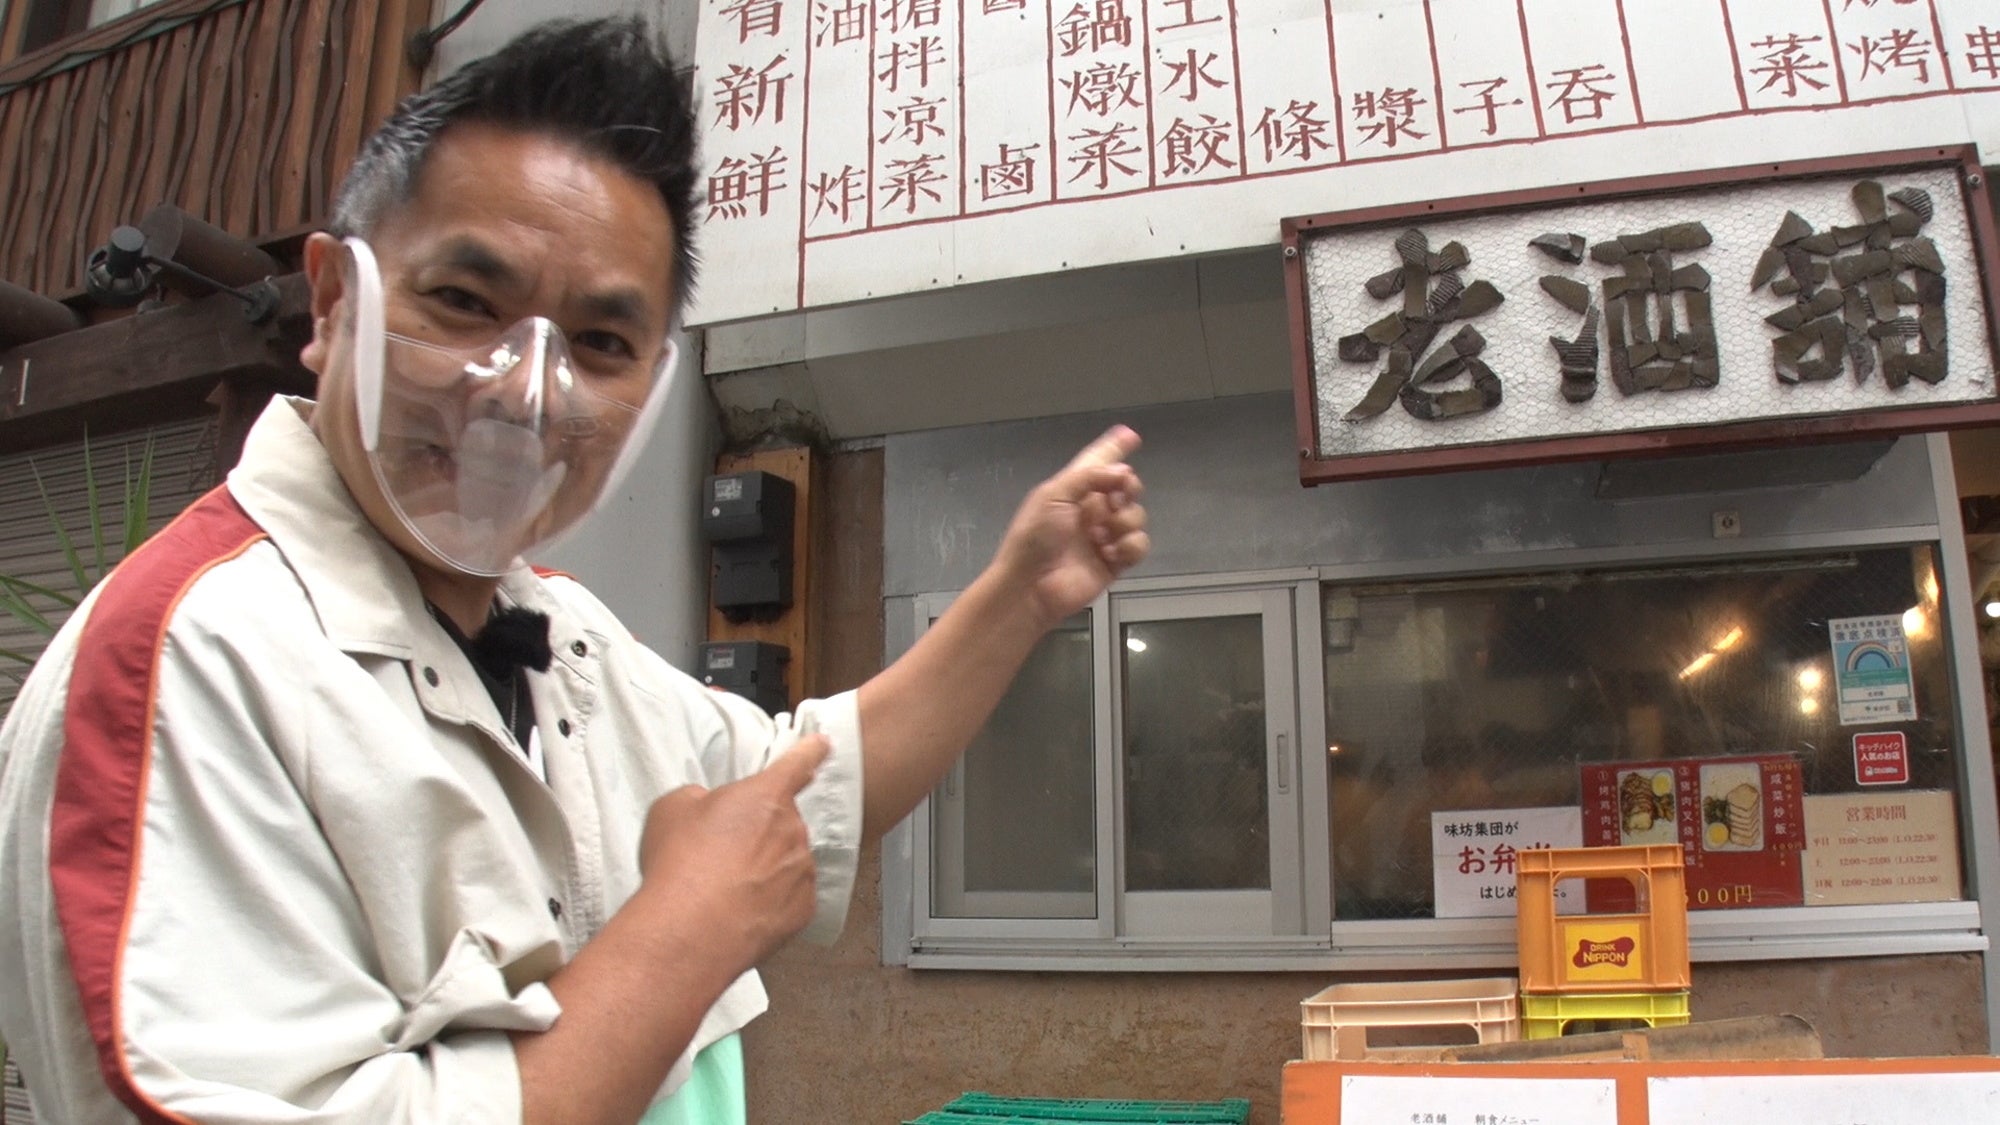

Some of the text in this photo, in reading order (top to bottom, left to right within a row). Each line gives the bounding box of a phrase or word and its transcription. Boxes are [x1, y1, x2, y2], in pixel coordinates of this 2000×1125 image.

[1840, 0, 1932, 84] 烤
[1749, 33, 1830, 97] 菜
[1453, 77, 1524, 135] 子
[1251, 100, 1334, 163] 條
[1861, 751, 1901, 761] 人気のお店
[1846, 805, 1906, 822] 営業時間
[1444, 821, 1519, 837] 味坊集団が
[1458, 842, 1550, 875] お弁
[1685, 884, 1751, 904] 00円
[1583, 951, 1625, 963] NIPPON
[1590, 944, 1616, 952] DRINK
